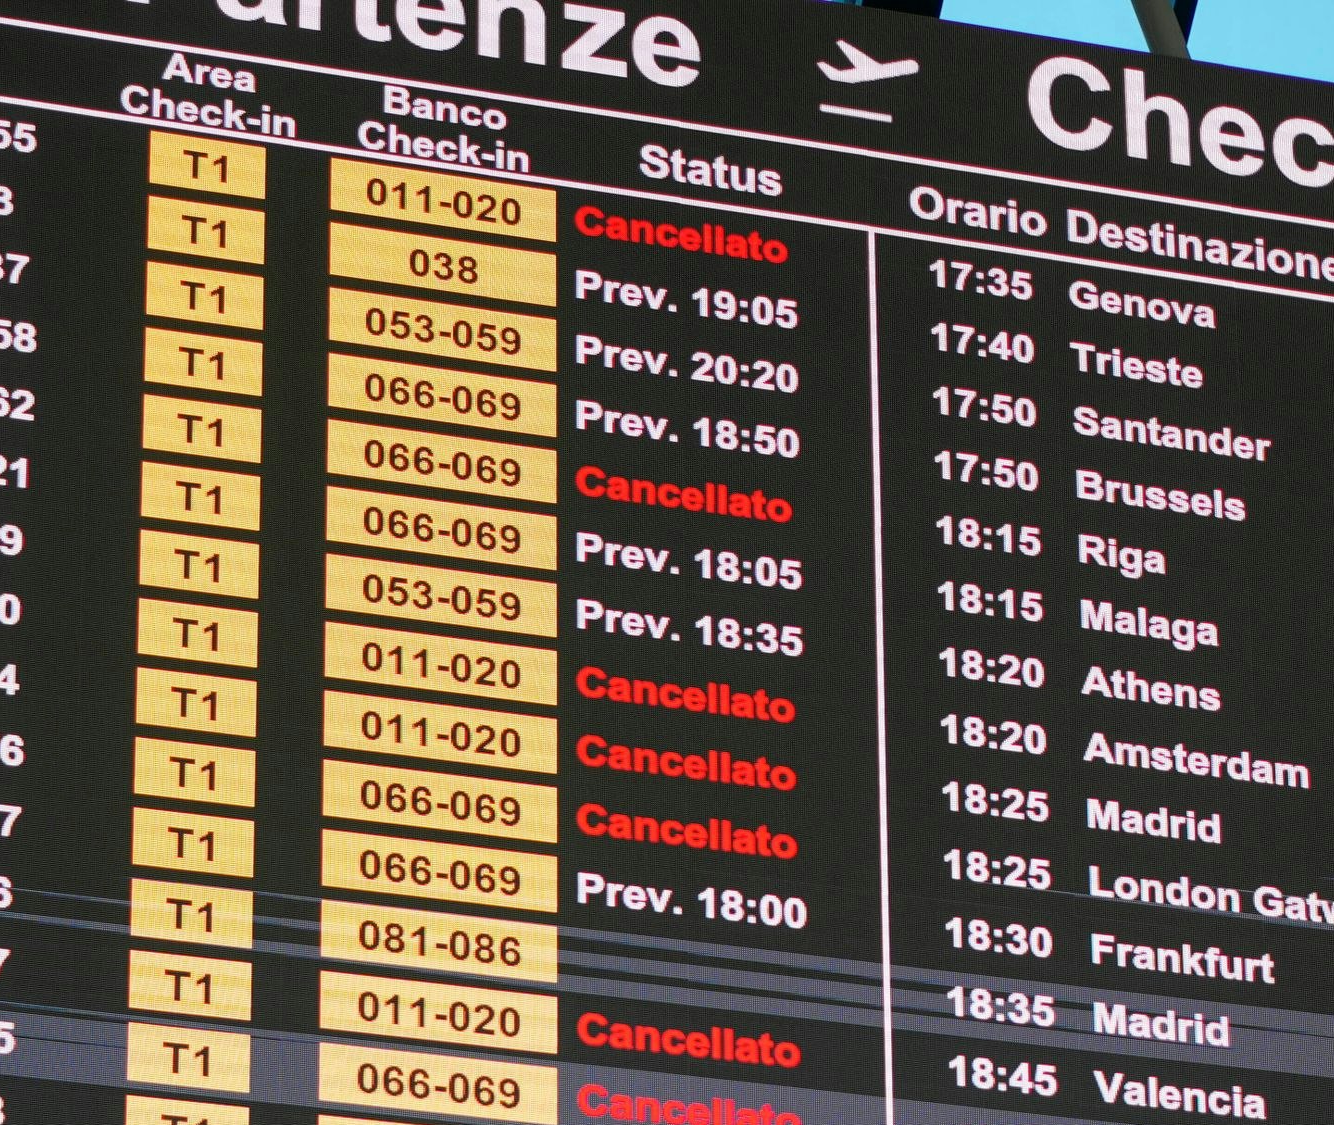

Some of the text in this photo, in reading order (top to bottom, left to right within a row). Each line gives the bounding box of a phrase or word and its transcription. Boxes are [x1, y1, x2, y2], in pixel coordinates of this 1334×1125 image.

[162, 51, 256, 94] Area
[119, 84, 296, 139] Check-in
[382, 83, 507, 131] Banco
[182, 148, 229, 184] T1
[357, 120, 530, 174] Check-in
[639, 143, 783, 197] Status
[573, 204, 789, 265] Cancellato
[908, 185, 1048, 237] Orario
[407, 247, 480, 286] 038
[929, 259, 1033, 301] 17:35
[575, 269, 798, 330] Prev. 19:05
[1068, 280, 1216, 329] Genova
[364, 306, 523, 357] 053-059
[1069, 341, 1203, 389] Trieste
[575, 399, 800, 459] Prev. 18:50
[932, 386, 1037, 428] 17:50
[1073, 405, 1271, 462] Santander
[574, 465, 794, 524] Cancellato
[1075, 469, 1246, 522] Brussels
[935, 515, 1042, 557] 18:15
[1077, 533, 1166, 580] Riga
[575, 598, 804, 658] Prev. 18:35
[1079, 598, 1219, 652] Malaga
[938, 646, 1045, 689] 18:20
[1081, 665, 1222, 712] Athens
[575, 733, 798, 792] Cancellato
[1082, 731, 1310, 790] Amsterdam
[1086, 797, 1222, 845] Madrid
[576, 871, 808, 930] Prev. 18:00
[1088, 864, 1241, 915] London
[357, 918, 523, 968] 081-086
[944, 916, 1054, 959] 18:30
[1090, 932, 1276, 985] Frankfurt
[1092, 1000, 1231, 1049] Madrid
[162, 1040, 211, 1078] T1
[948, 1054, 1058, 1098] 18:45
[1092, 1069, 1266, 1121] Valencia
